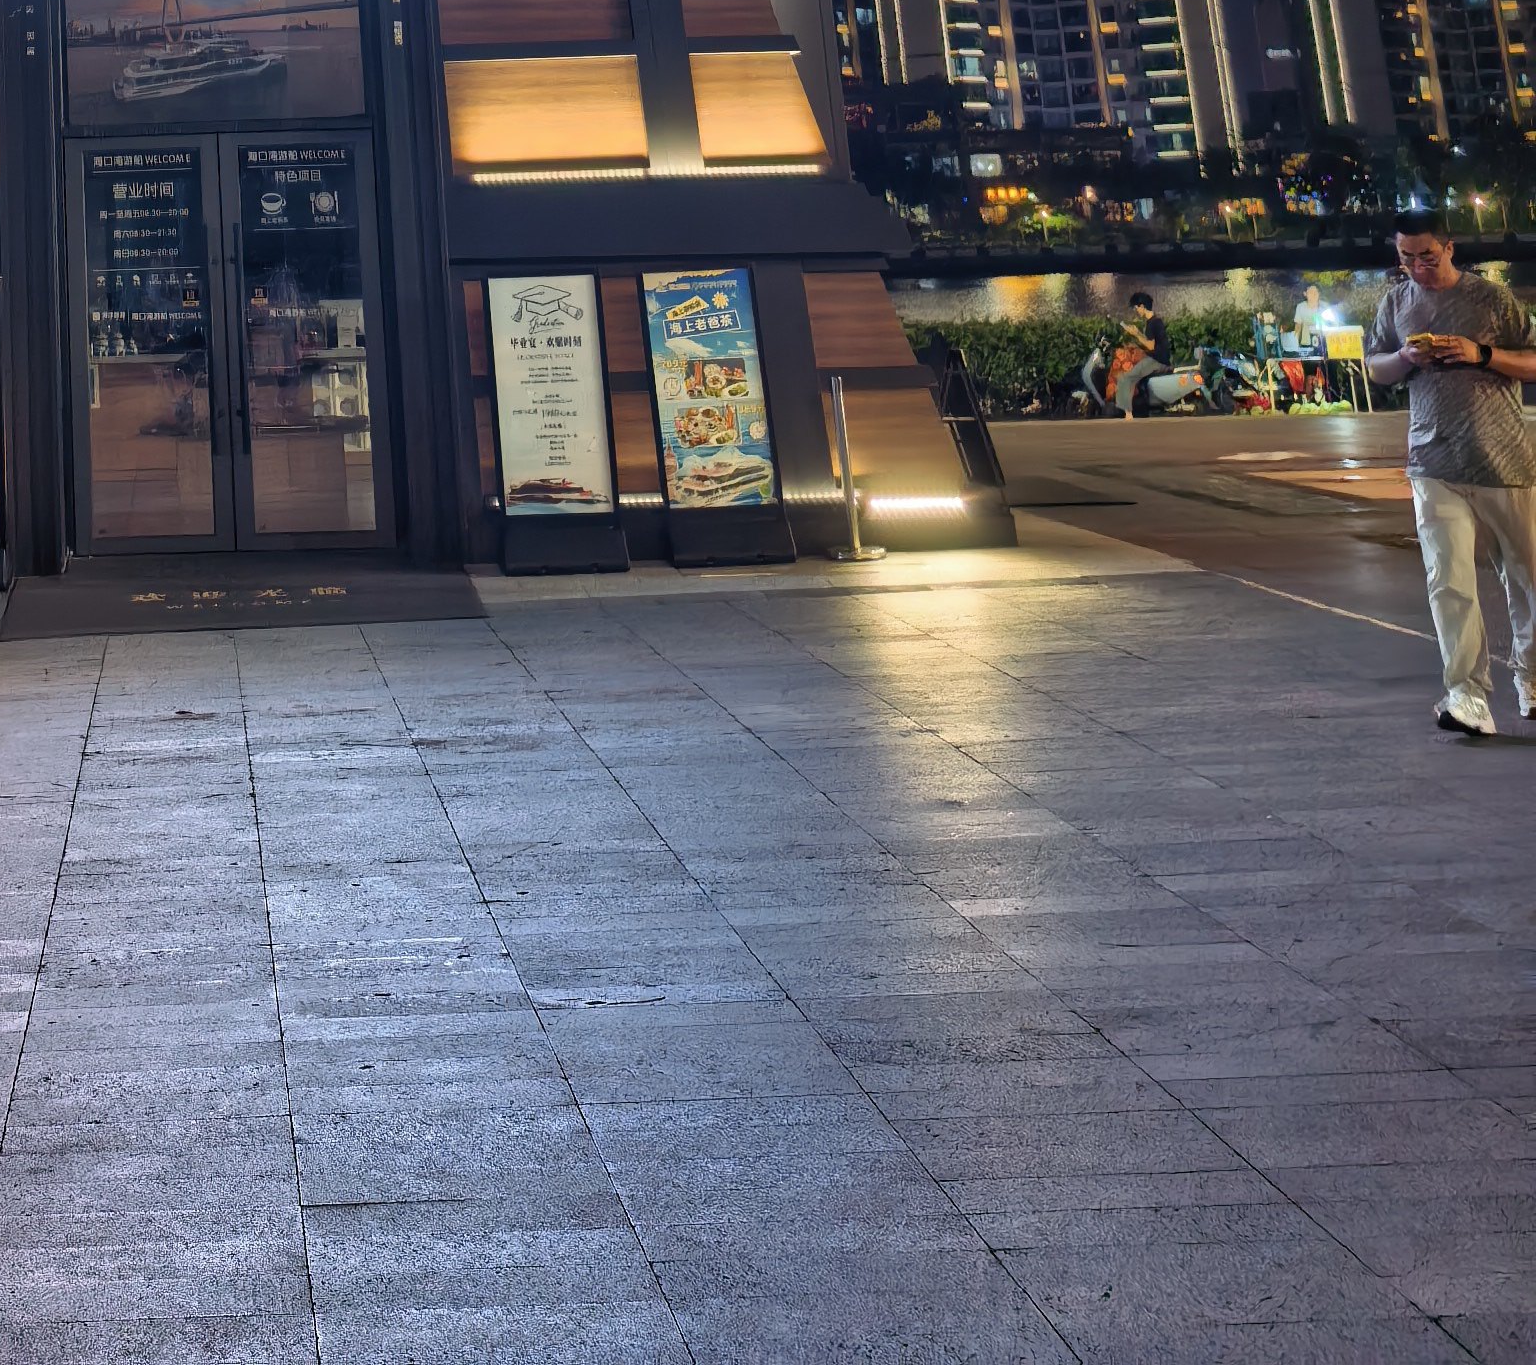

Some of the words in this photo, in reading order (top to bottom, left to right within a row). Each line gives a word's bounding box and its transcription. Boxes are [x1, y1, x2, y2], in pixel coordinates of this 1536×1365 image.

[145, 153, 192, 165] WELCOME
[300, 149, 346, 160] WELCOME
[112, 182, 174, 200] 营业时间
[669, 314, 733, 336] 海上老爸茶
